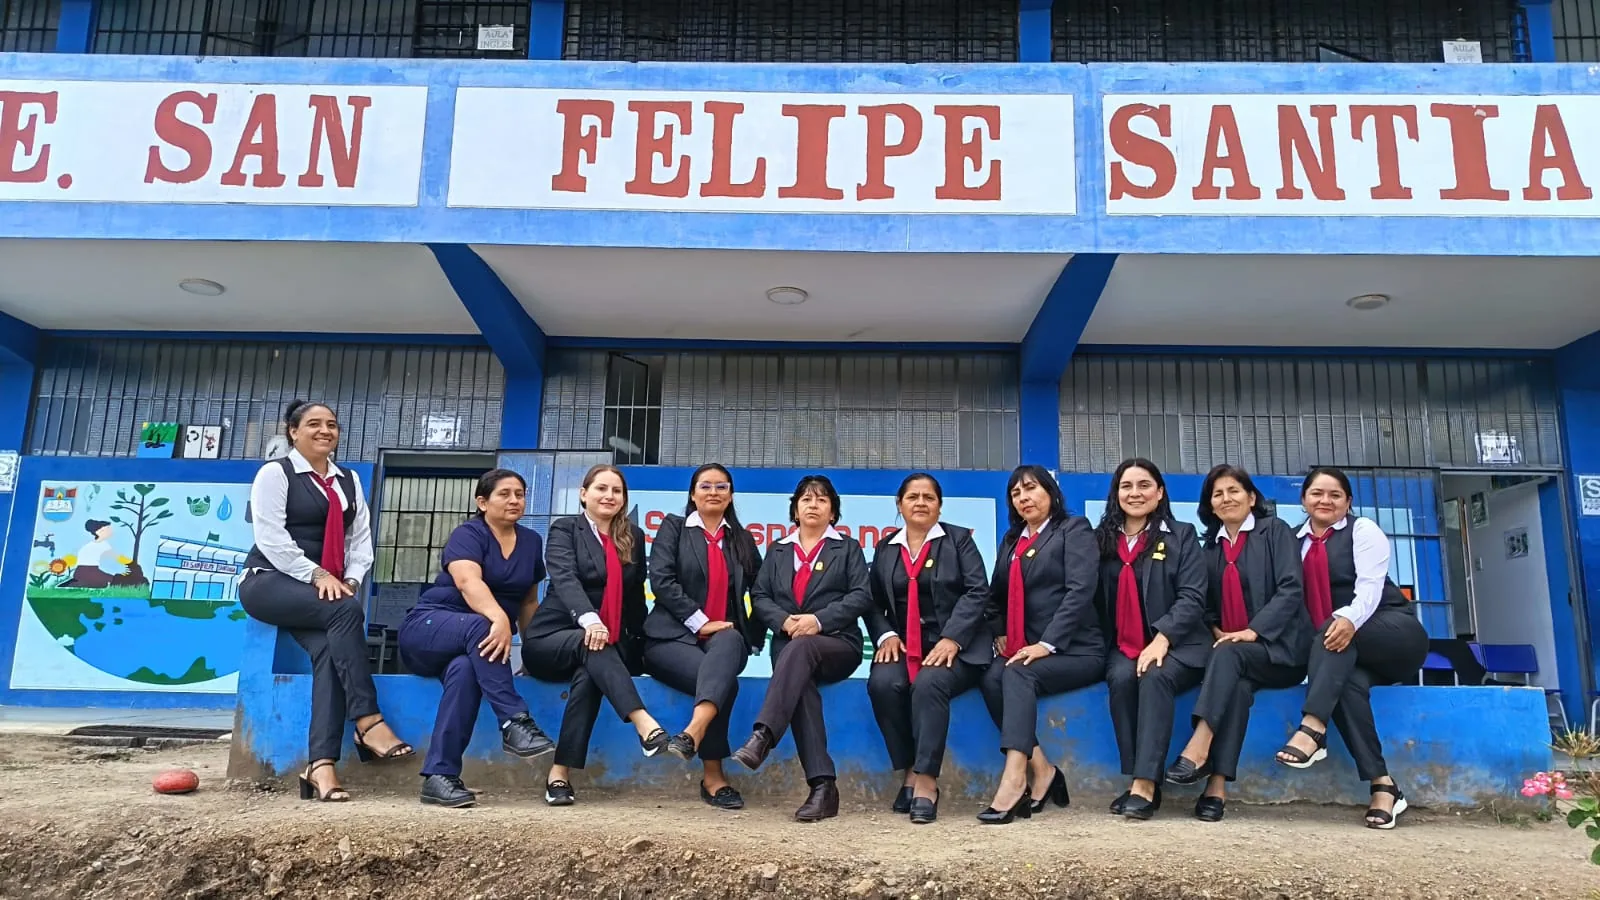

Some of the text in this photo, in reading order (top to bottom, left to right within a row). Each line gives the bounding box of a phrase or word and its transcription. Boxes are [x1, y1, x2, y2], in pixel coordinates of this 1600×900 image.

[144, 90, 372, 188] SAN
[552, 100, 1002, 202] FELIPE
[1108, 104, 1593, 201] SANTIA
